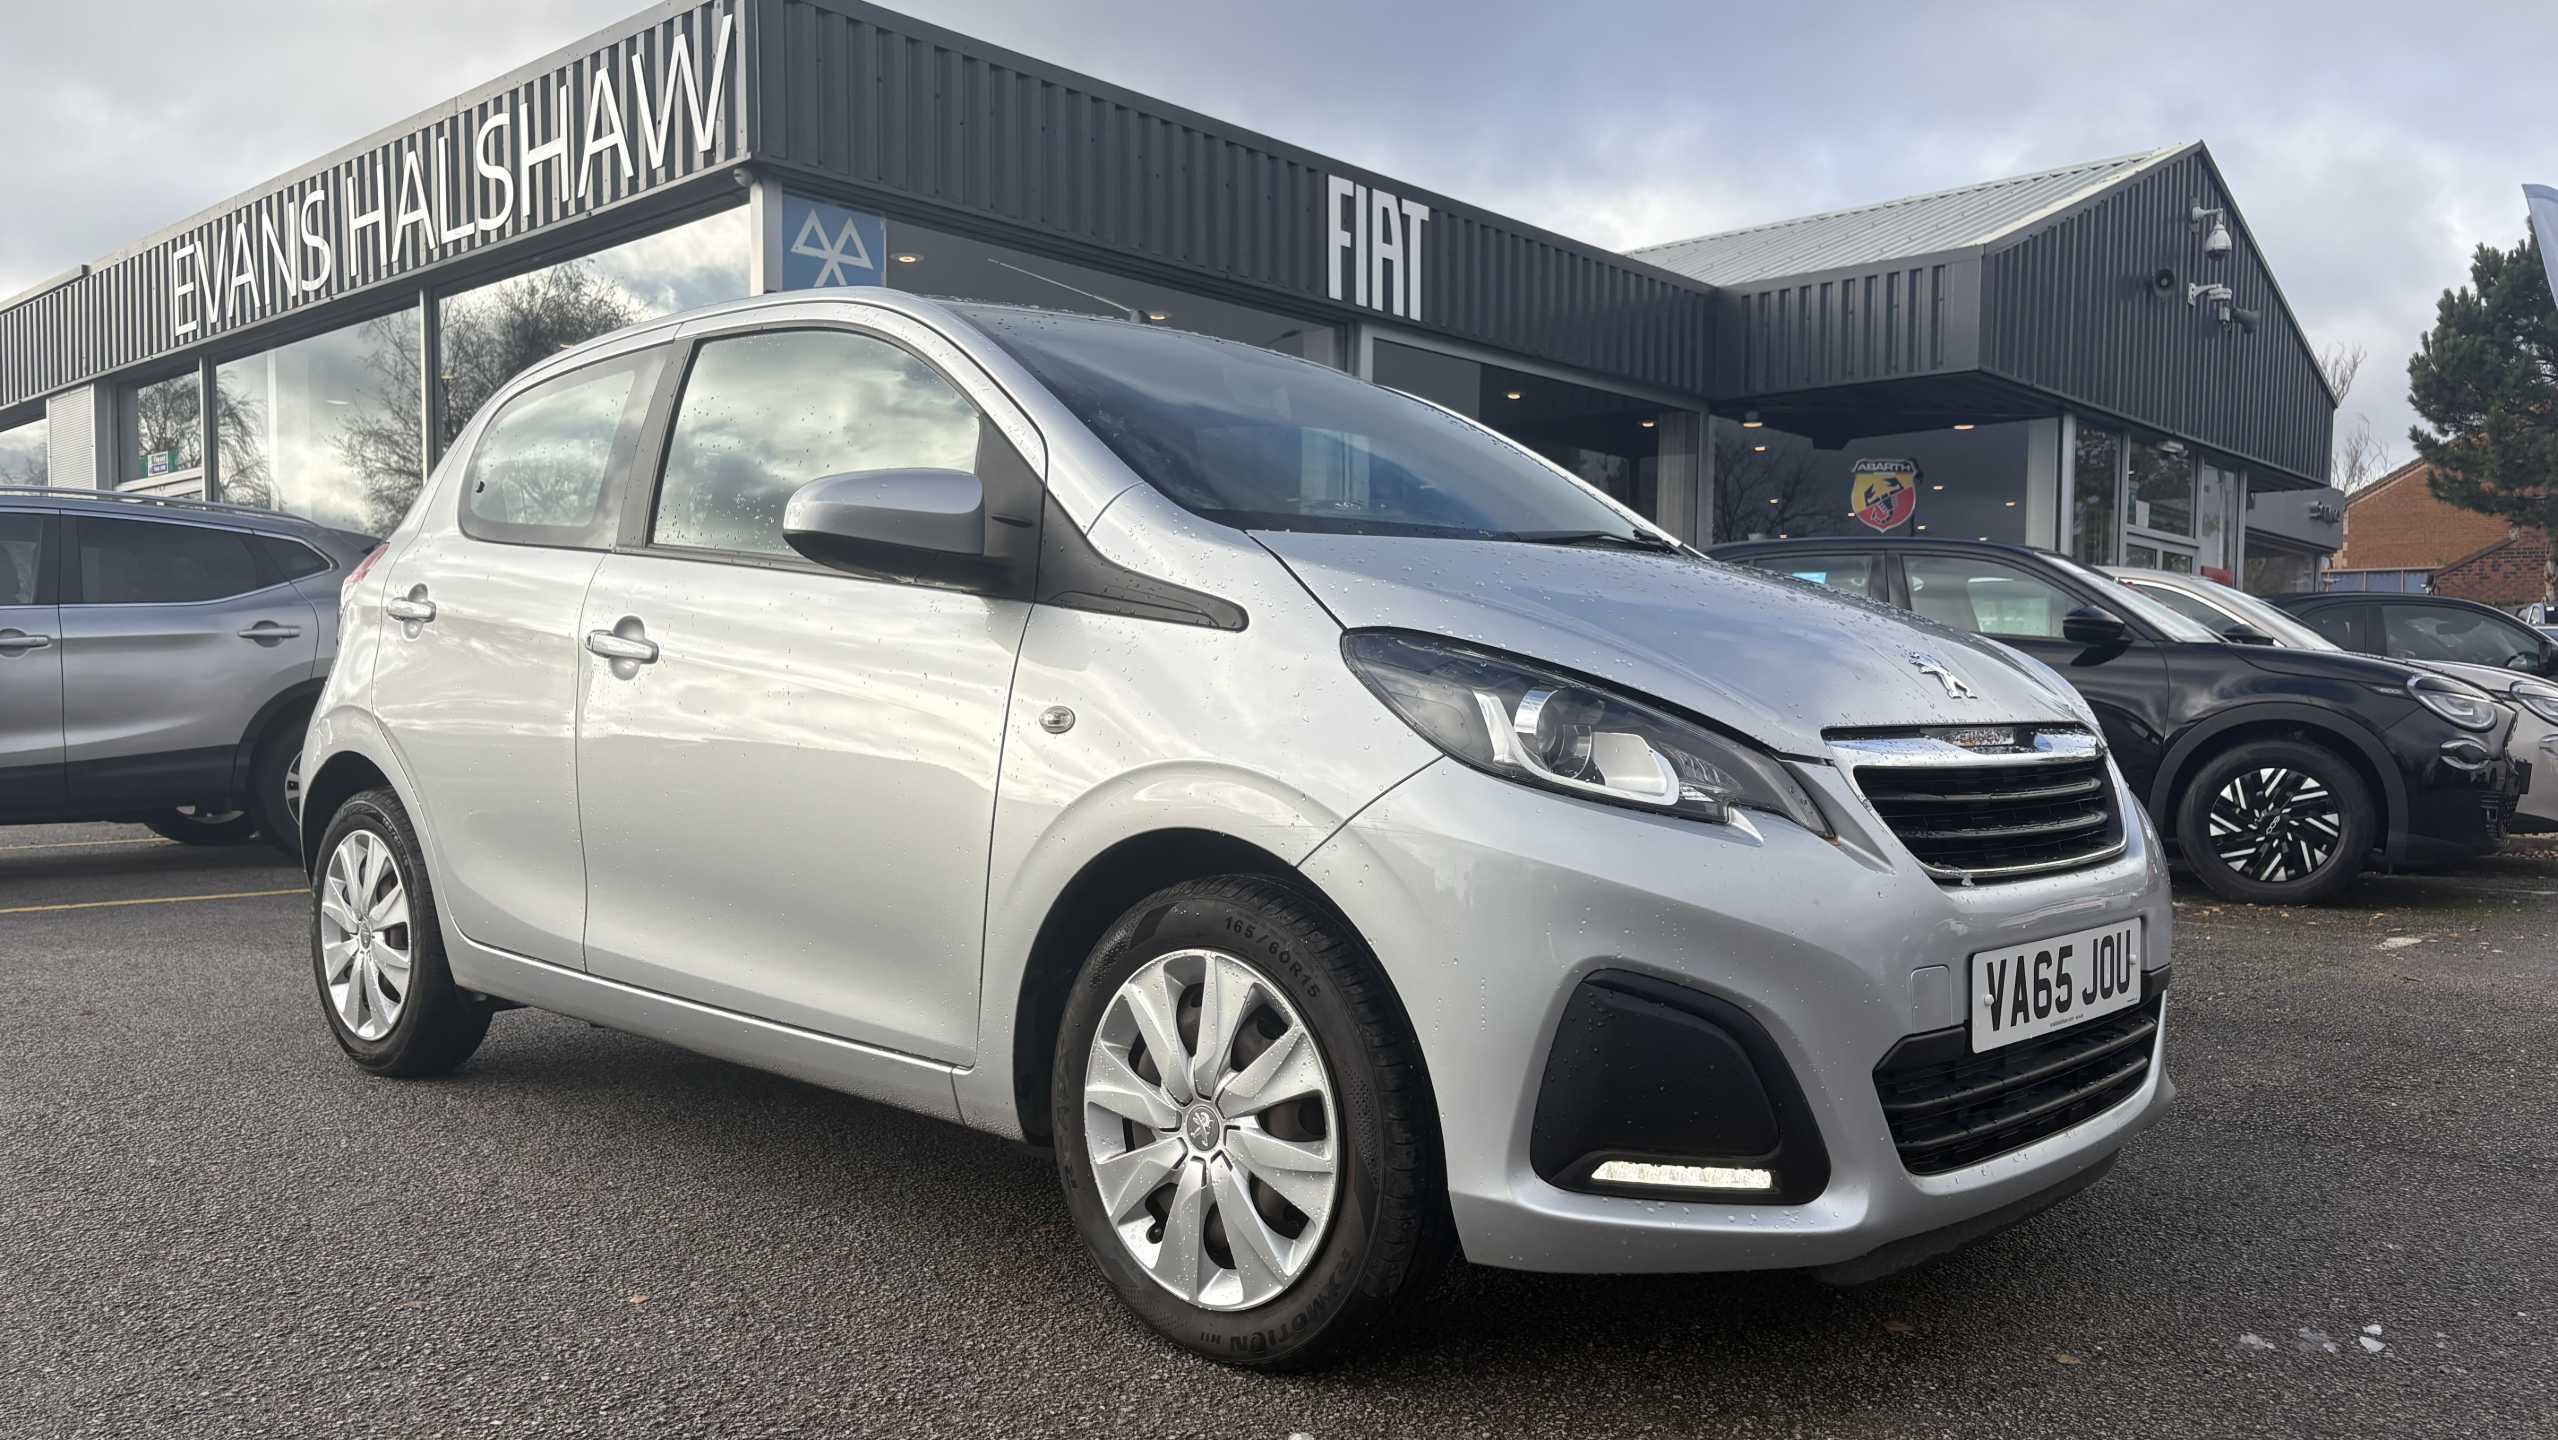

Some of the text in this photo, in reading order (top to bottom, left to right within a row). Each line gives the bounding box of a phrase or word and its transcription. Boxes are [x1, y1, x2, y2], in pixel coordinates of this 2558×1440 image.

[173, 14, 734, 338] EVANS HALSHAW
[1328, 174, 1430, 321] FIAT
[1857, 462, 1911, 472] ABARTH
[1224, 916, 1321, 998] 165/60R15
[1986, 929, 2131, 1032] VA65 JOU
